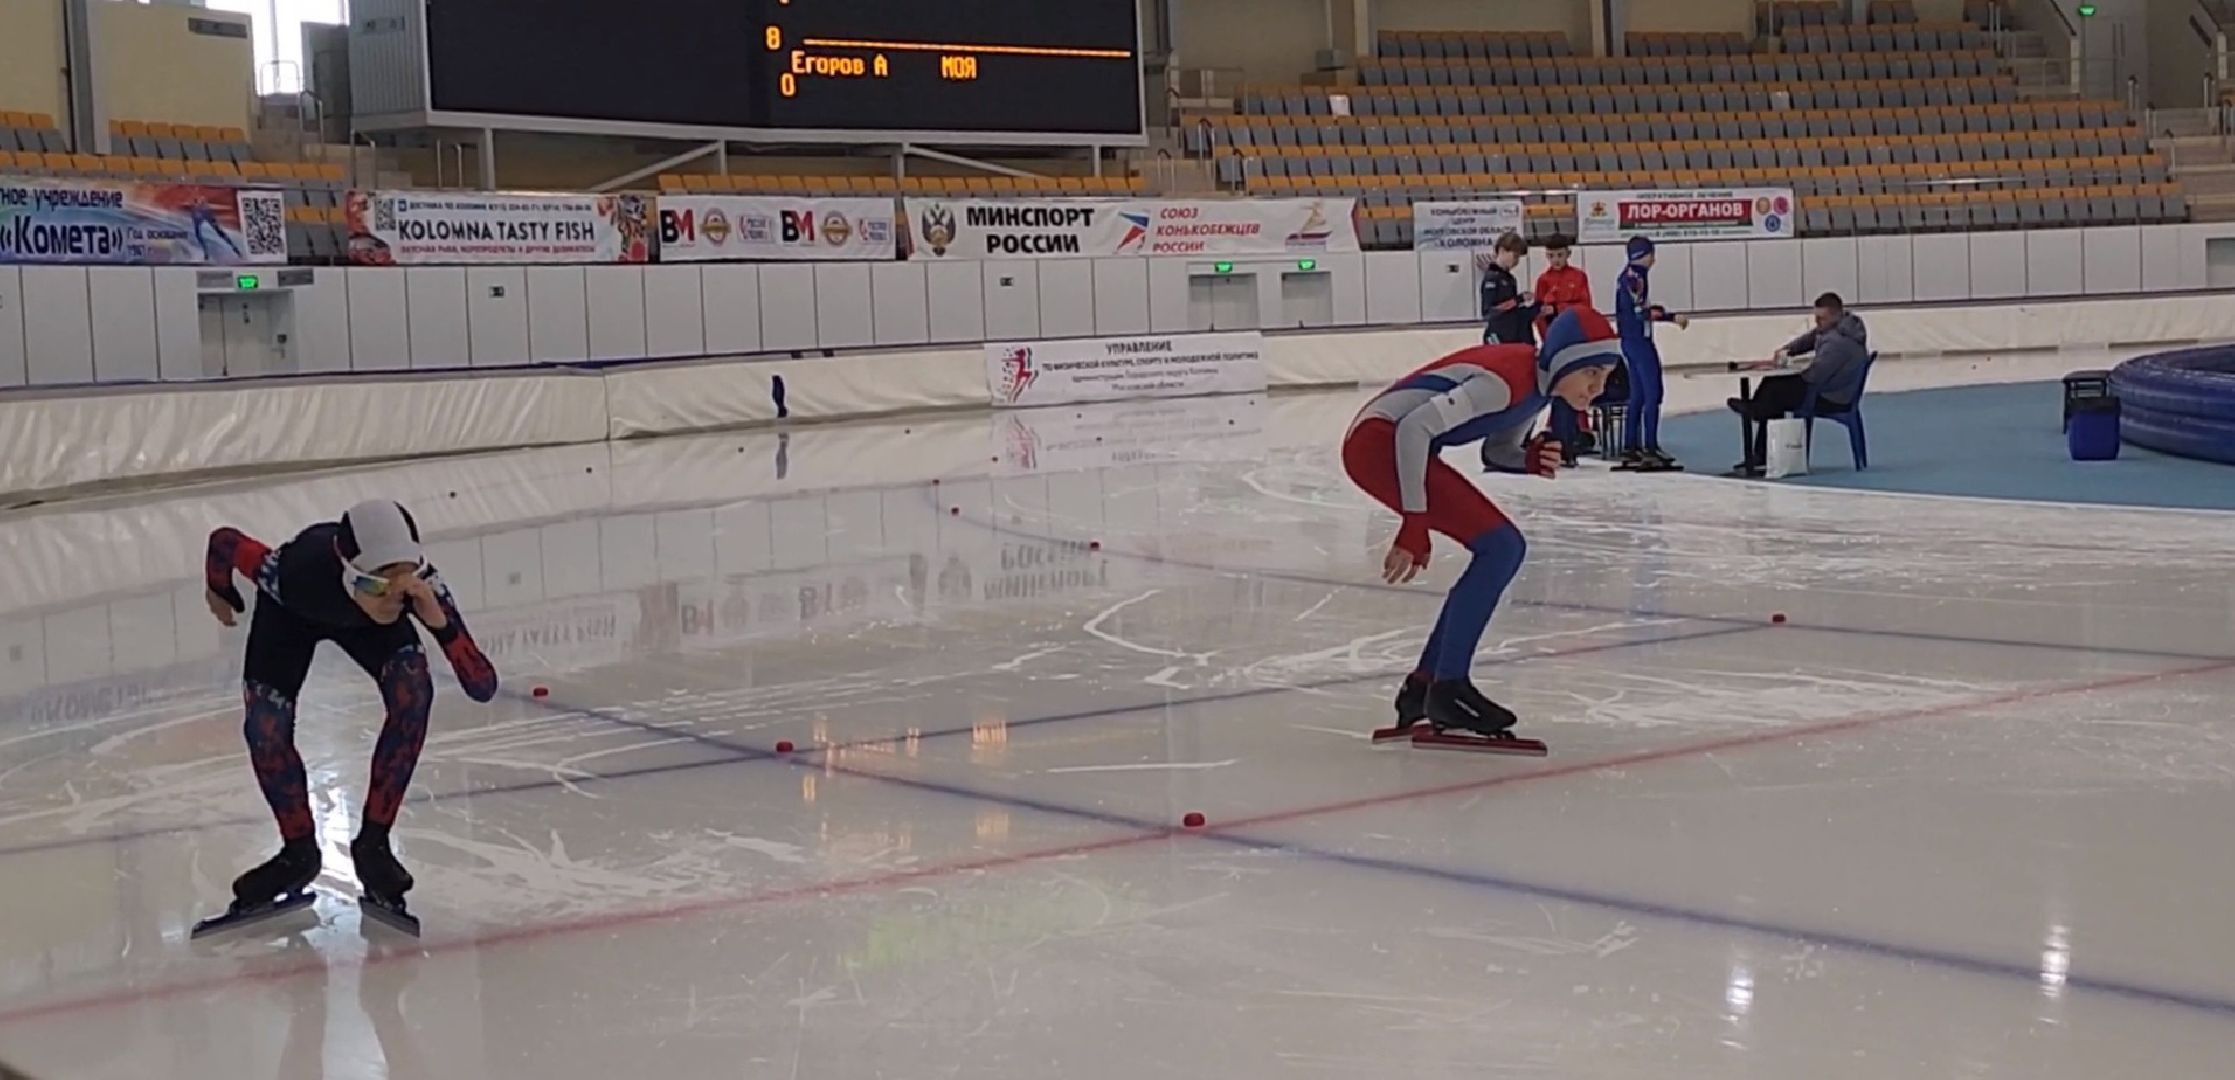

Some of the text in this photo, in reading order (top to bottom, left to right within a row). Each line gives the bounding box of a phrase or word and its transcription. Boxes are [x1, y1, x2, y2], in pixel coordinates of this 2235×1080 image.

[791, 50, 864, 77] Егоров
[33, 189, 123, 211] учреждение
[967, 206, 1094, 228] МИНСПОРТ
[1160, 208, 1199, 219] СОЮЗ
[1628, 202, 1743, 219] ЛОР-ОРГАНОВ
[400, 220, 594, 240] KOLOMNA TASTY FISH
[986, 233, 1080, 254] РОССИИ
[1152, 241, 1205, 252] РОССИИ
[1105, 340, 1172, 354] УПРАВЛЕНИЕ
